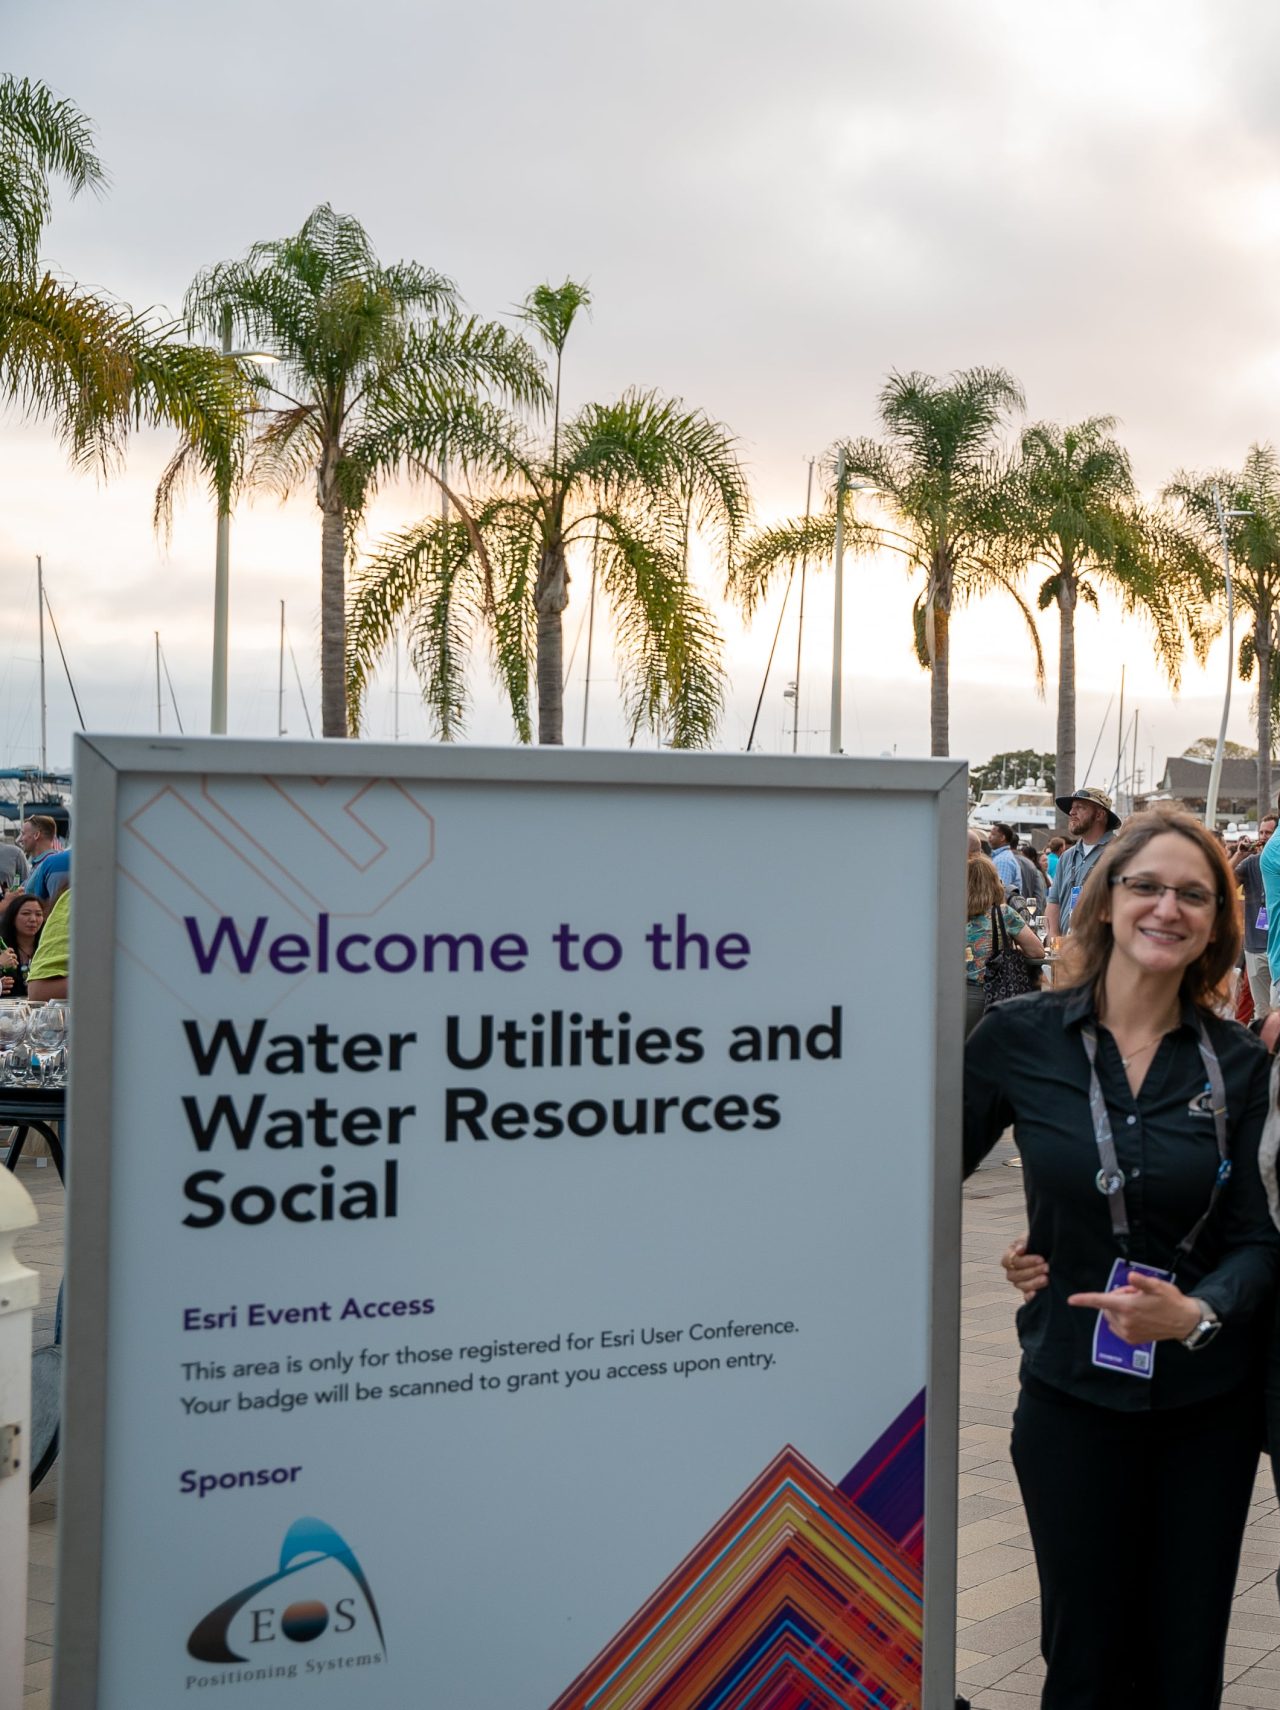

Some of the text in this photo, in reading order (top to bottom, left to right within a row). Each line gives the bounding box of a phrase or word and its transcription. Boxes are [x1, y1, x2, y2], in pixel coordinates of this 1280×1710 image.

[184, 913, 750, 974] Welcome to the
[182, 1005, 842, 1076] Water Utilities and
[181, 1088, 781, 1152] Water Resources
[182, 1159, 398, 1229] Social
[184, 1298, 435, 1331] Esri Event Access
[181, 1320, 799, 1380] This area is only for those registered for Esri User Conference.
[181, 1353, 776, 1414] Your badge will be scanned to grant you access upon entry.
[178, 1465, 303, 1499] Sponsor
[185, 1653, 383, 1690] Positioning Systems
